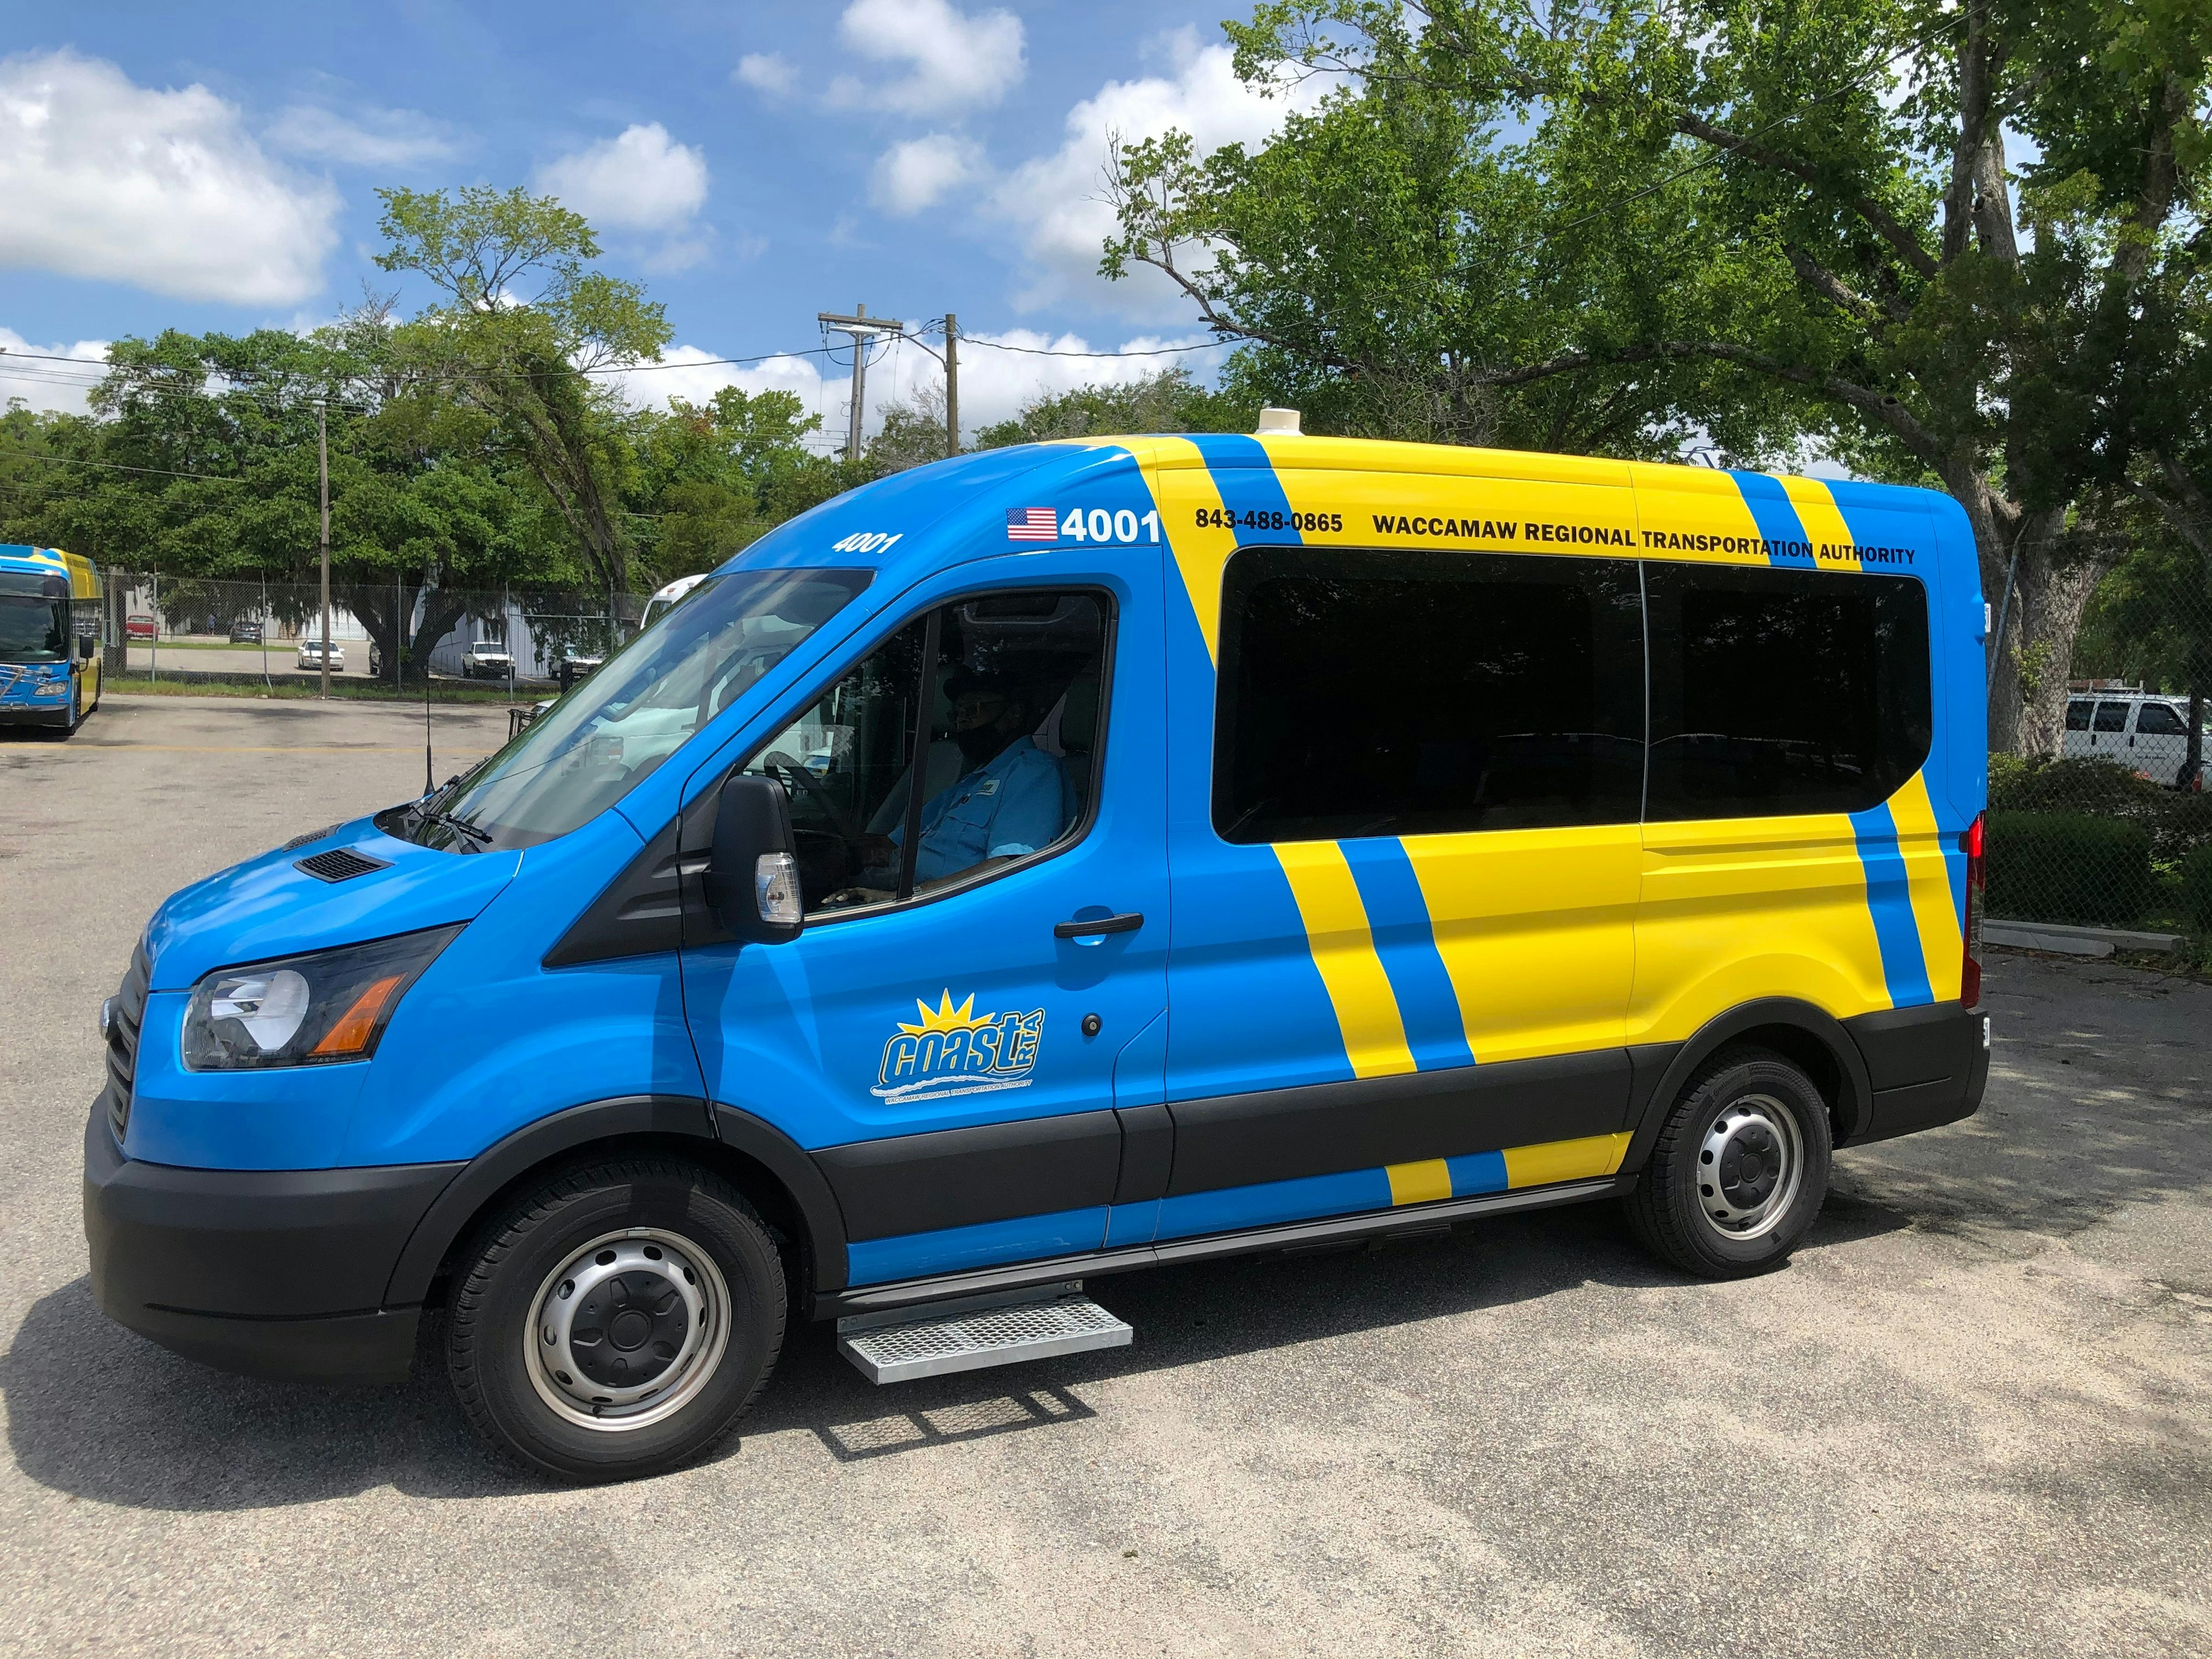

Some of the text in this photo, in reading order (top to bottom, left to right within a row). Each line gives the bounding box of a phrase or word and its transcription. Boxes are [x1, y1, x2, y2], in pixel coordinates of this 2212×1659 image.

[1062, 509, 1160, 543] 4001
[1195, 509, 1343, 532] 843-488-0865
[832, 532, 904, 554] 4001
[1373, 515, 1915, 565] WACCAMAW REGIONAL TRANSPORTATION AUTHORITY
[1015, 1012, 1041, 1066] RTA
[886, 1080, 1032, 1103] WACCAMAW REGIONAL TRANSPORTATION AUTHORITY
